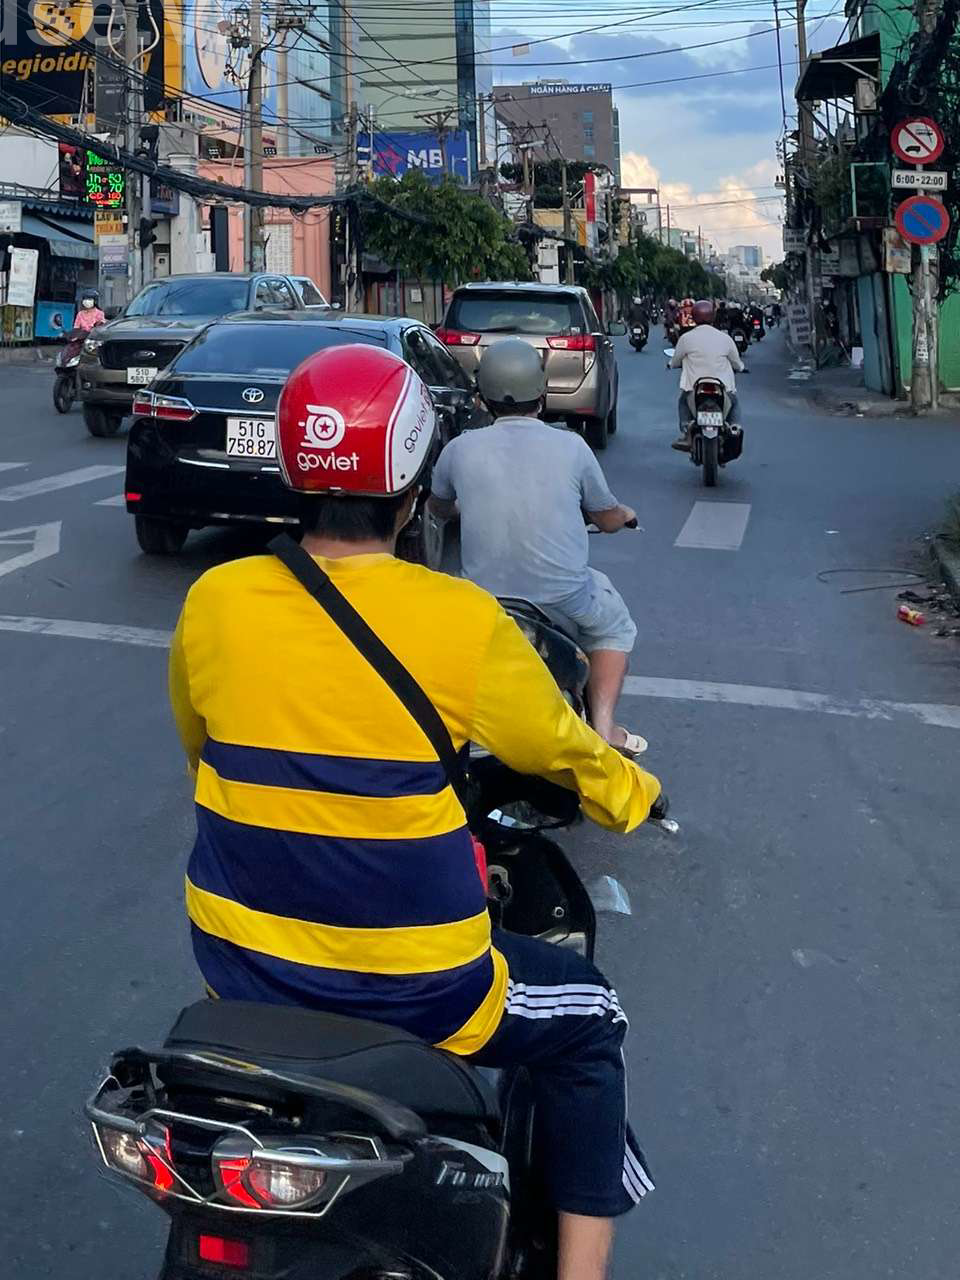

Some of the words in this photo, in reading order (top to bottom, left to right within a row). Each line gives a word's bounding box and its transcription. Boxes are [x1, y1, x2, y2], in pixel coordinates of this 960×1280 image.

[407, 148, 443, 169] MB
[239, 421, 265, 438] 51G
[228, 437, 275, 457] 758.87
[297, 451, 360, 472] goviet
